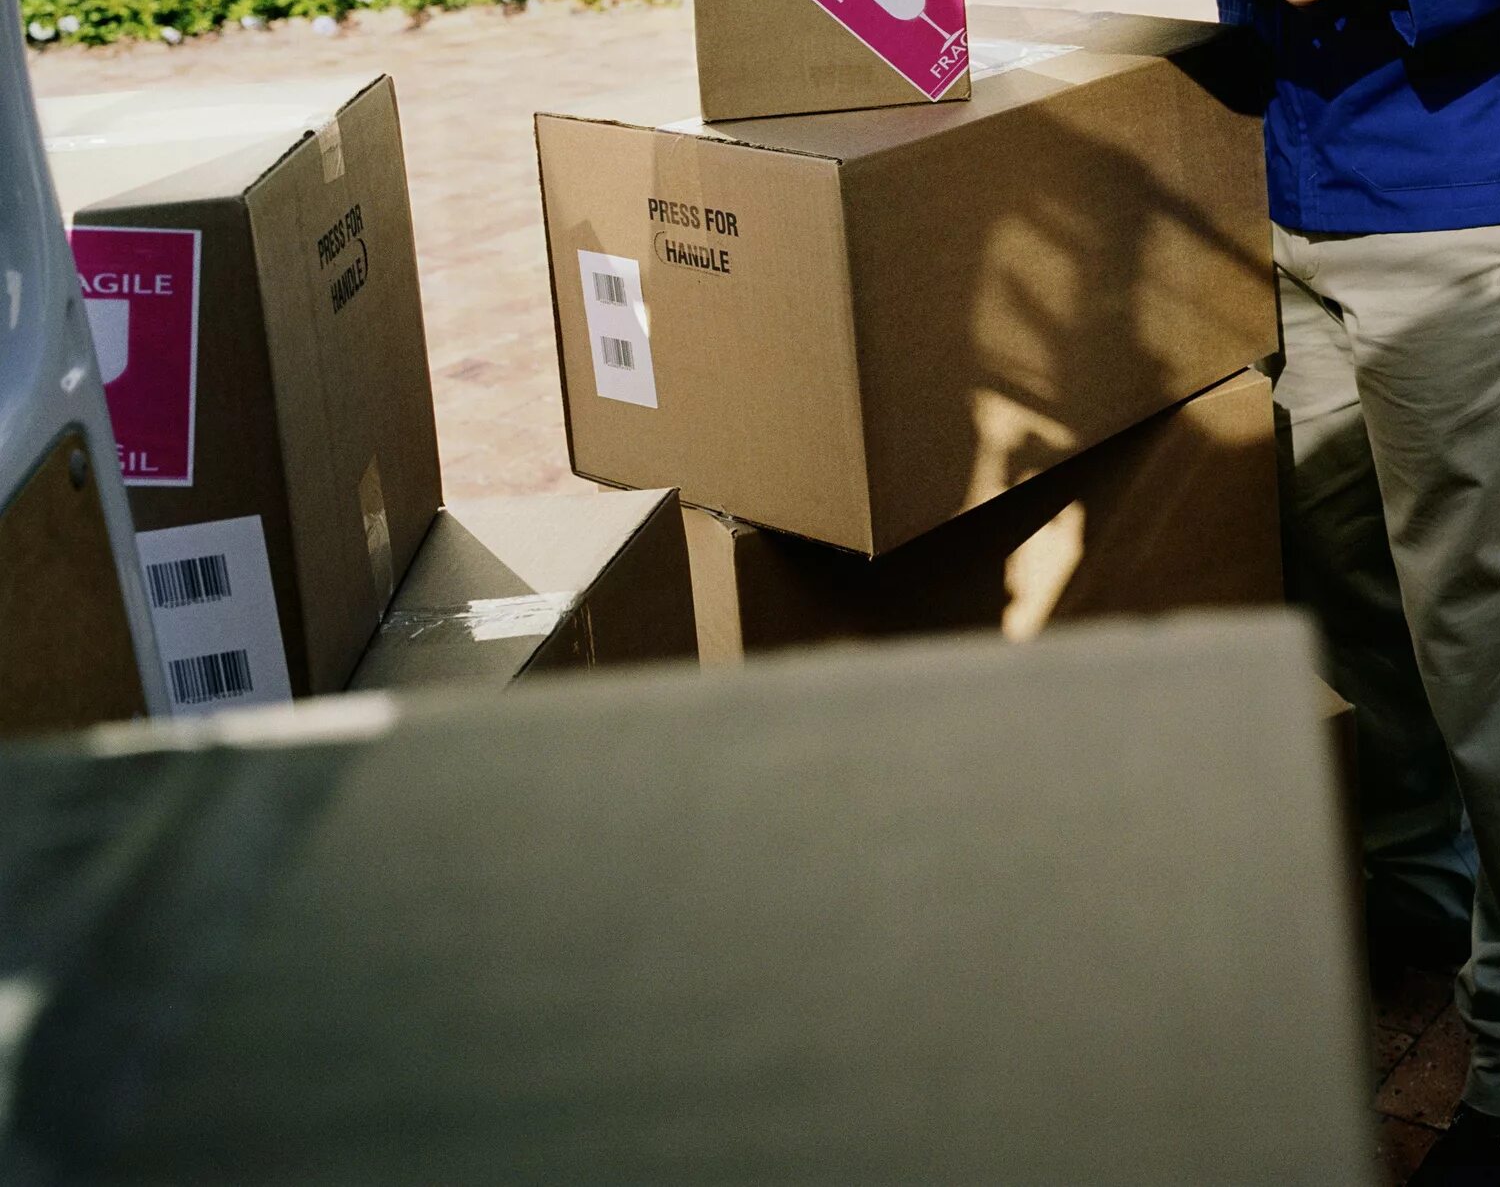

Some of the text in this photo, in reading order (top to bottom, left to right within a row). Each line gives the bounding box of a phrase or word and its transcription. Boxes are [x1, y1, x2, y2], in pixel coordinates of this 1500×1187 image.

[317, 203, 364, 270] PRESS FOR
[647, 198, 739, 237] PRESS FOR
[664, 239, 731, 274] HANDLE
[330, 257, 365, 315] HANDLE
